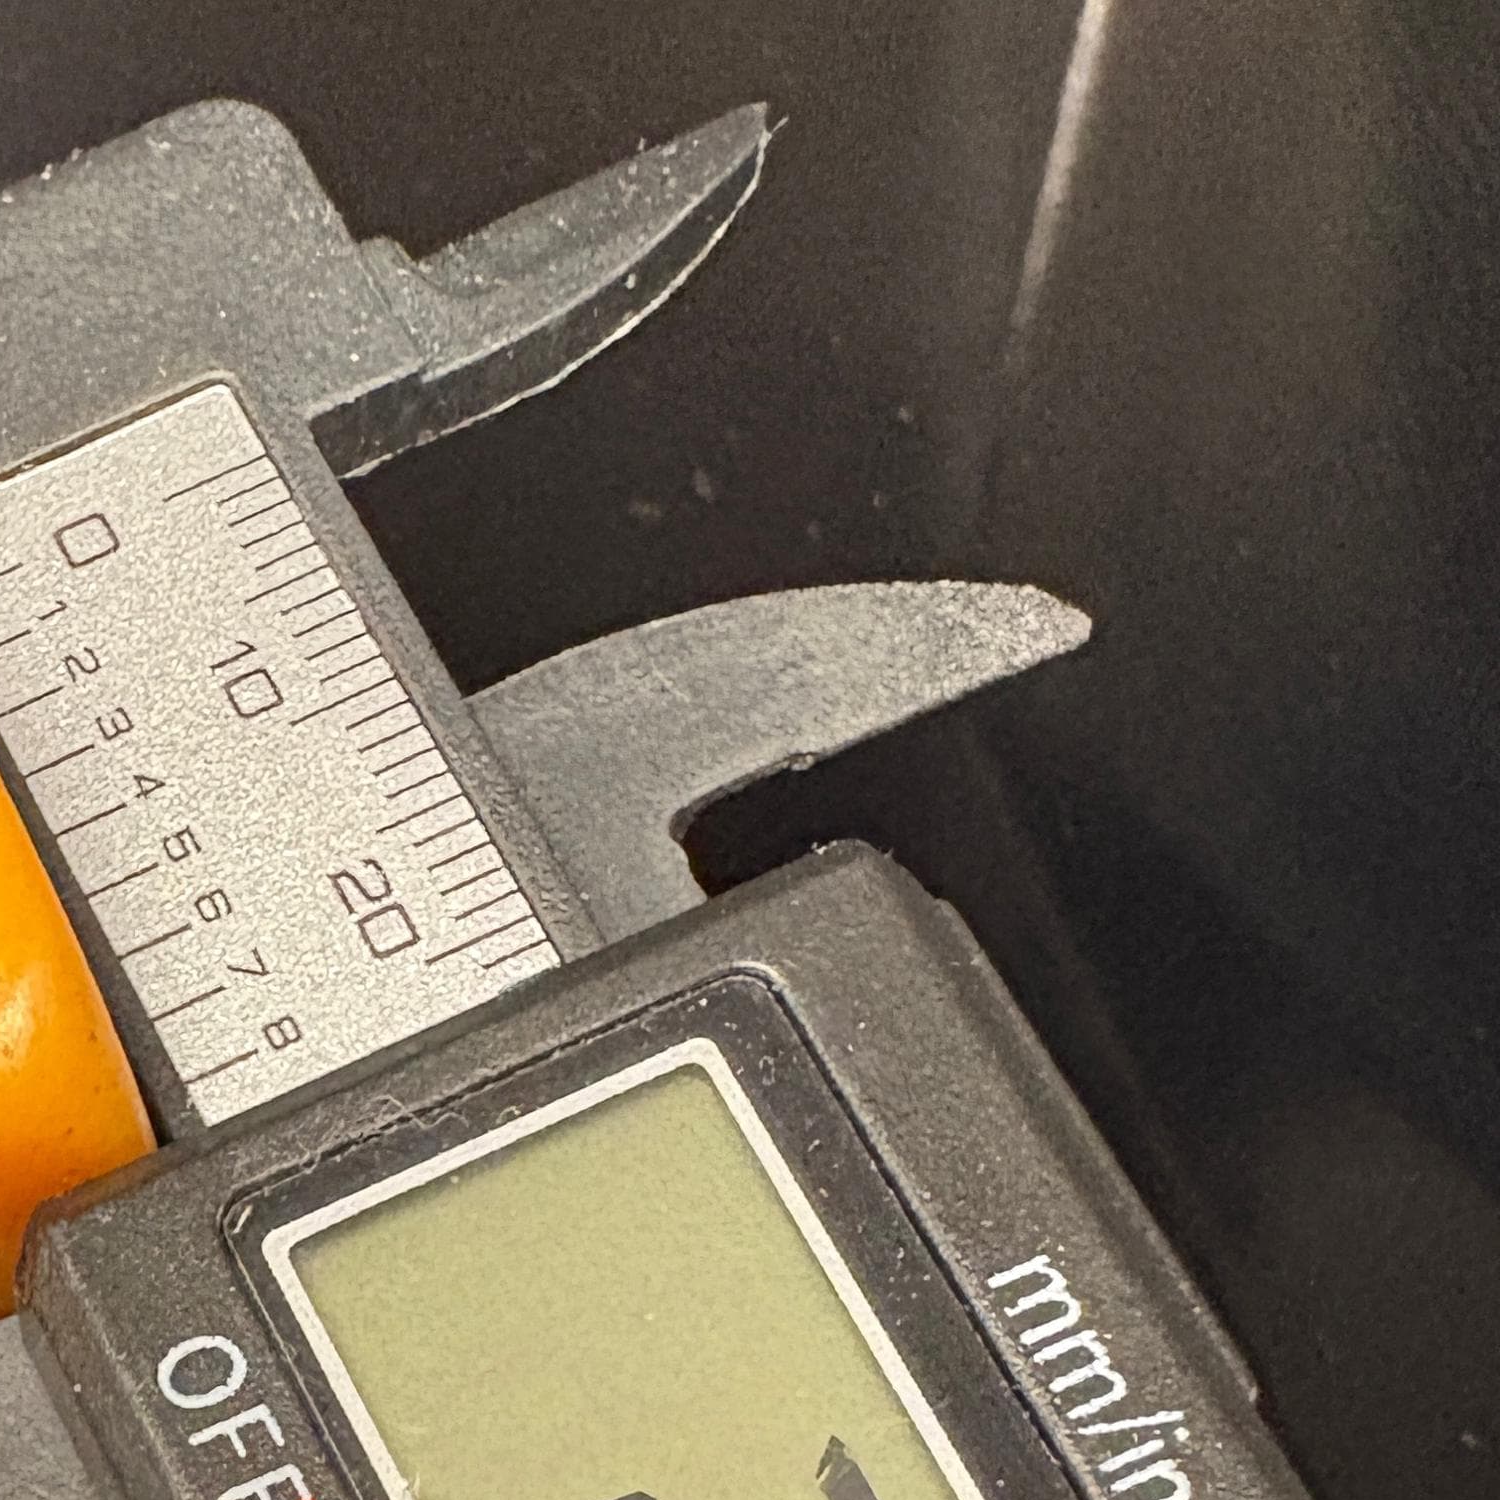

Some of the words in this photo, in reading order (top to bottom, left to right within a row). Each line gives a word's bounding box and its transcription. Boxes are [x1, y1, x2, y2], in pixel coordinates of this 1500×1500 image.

[54, 512, 120, 568] 0
[36, 599, 69, 622] 1
[63, 646, 102, 683] 2
[209, 639, 286, 719] 10
[95, 706, 135, 742] 3
[132, 772, 167, 802] 4
[163, 825, 203, 864] 5
[197, 887, 235, 924] 6
[328, 857, 423, 961] 20
[226, 947, 272, 982] 7
[263, 1015, 303, 1052] 8
